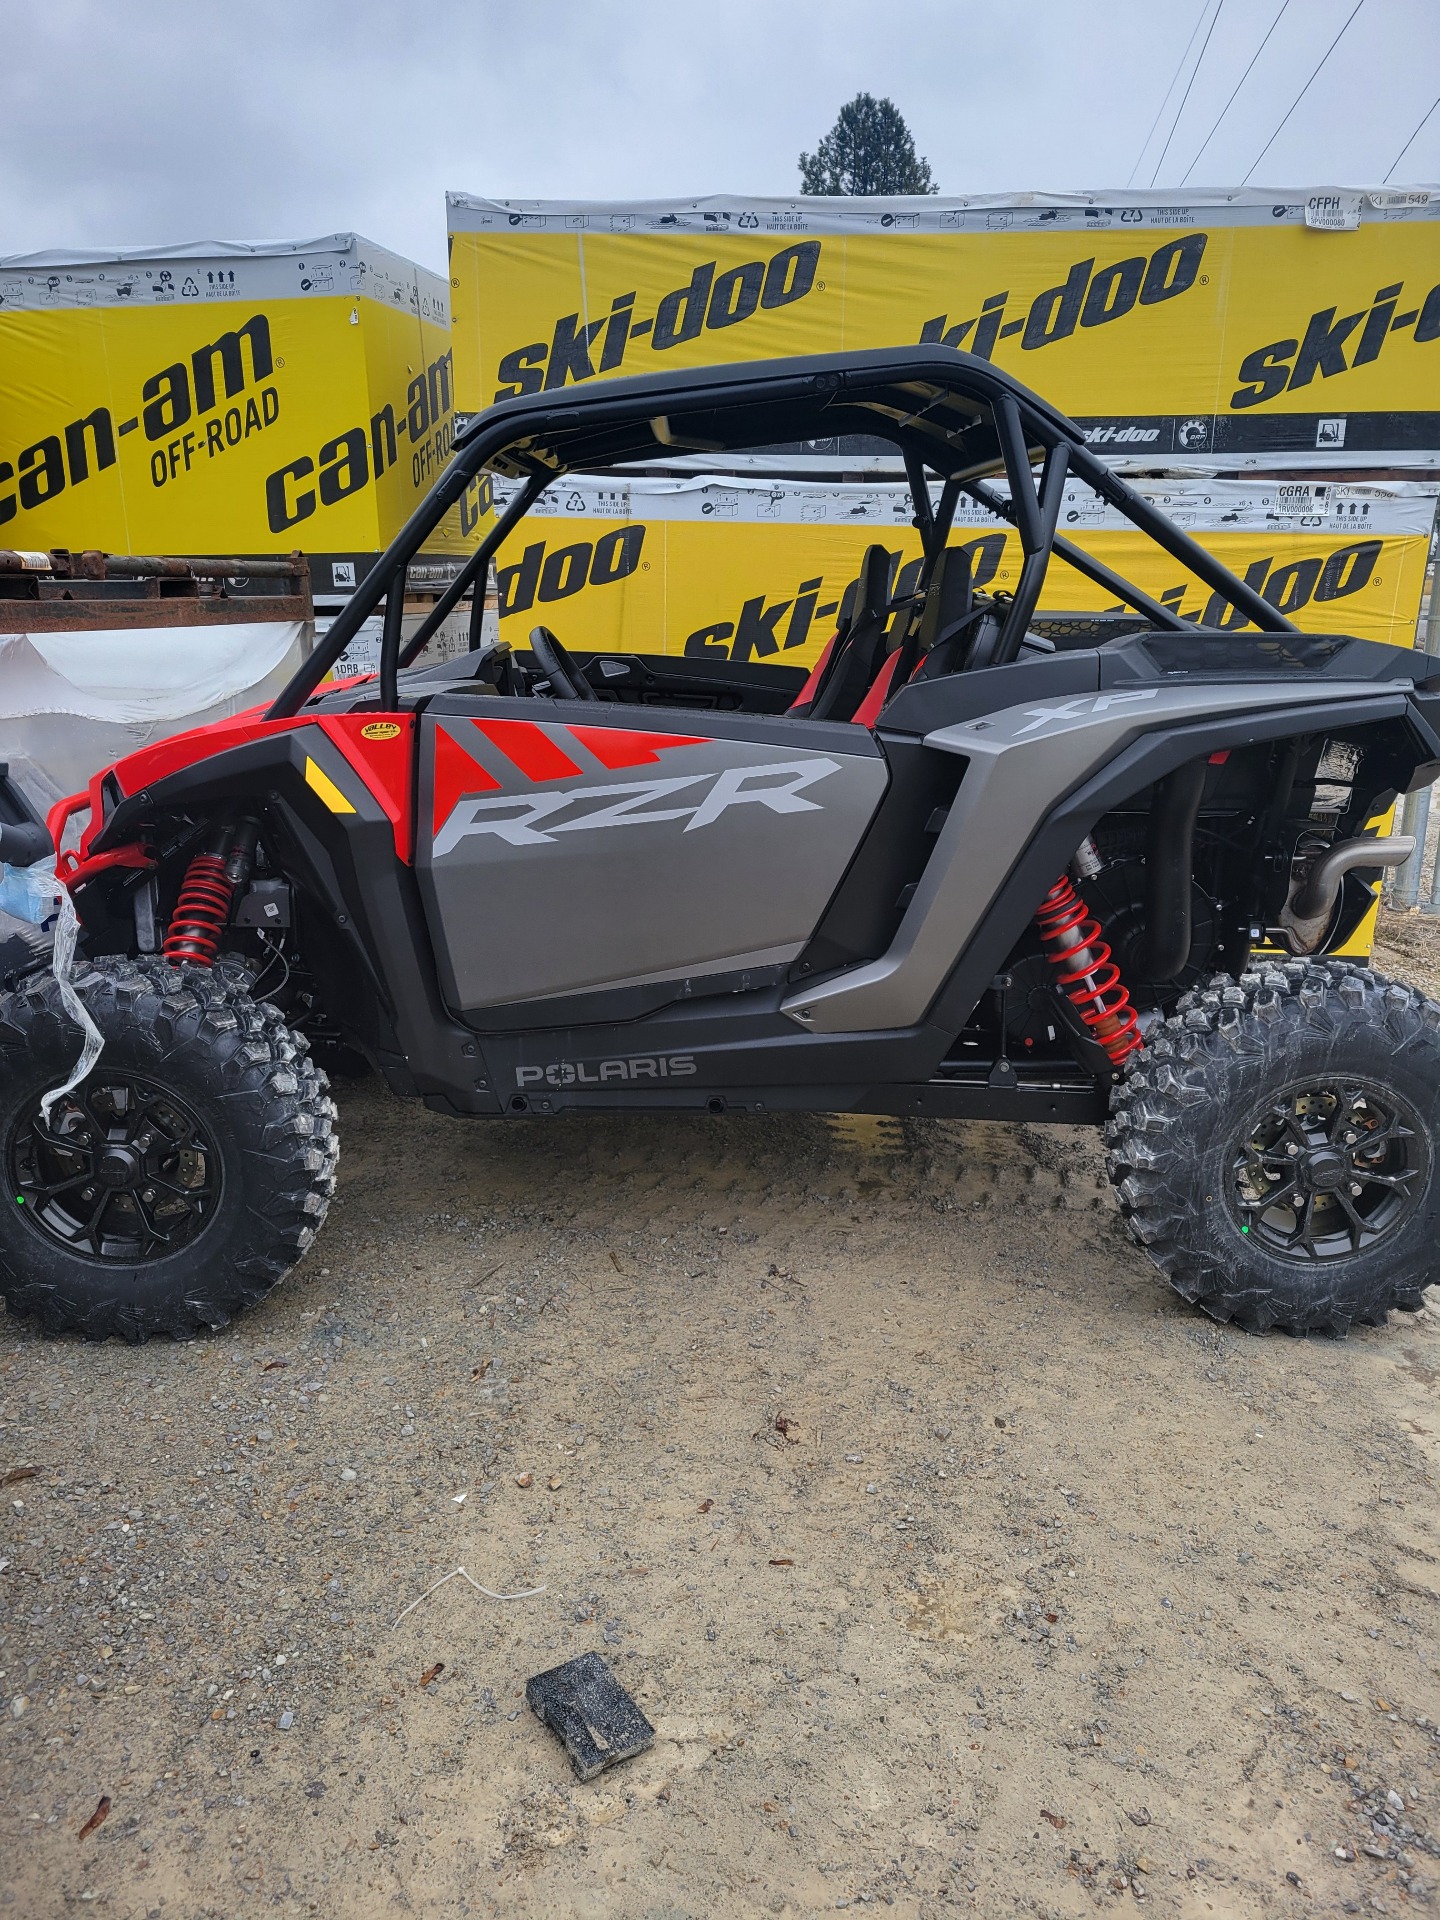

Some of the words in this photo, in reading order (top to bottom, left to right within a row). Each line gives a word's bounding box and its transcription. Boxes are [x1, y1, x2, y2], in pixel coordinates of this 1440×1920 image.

[1309, 197, 1340, 209] CFPH
[1408, 195, 1428, 204] 549
[494, 241, 821, 403] ski-doo
[151, 387, 279, 487] OFF-ROAD
[1279, 486, 1310, 496] CGRA
[410, 566, 443, 579] can-am
[1011, 689, 1159, 737] XP
[433, 757, 842, 858] RZR
[516, 1056, 697, 1087] POLARIS
